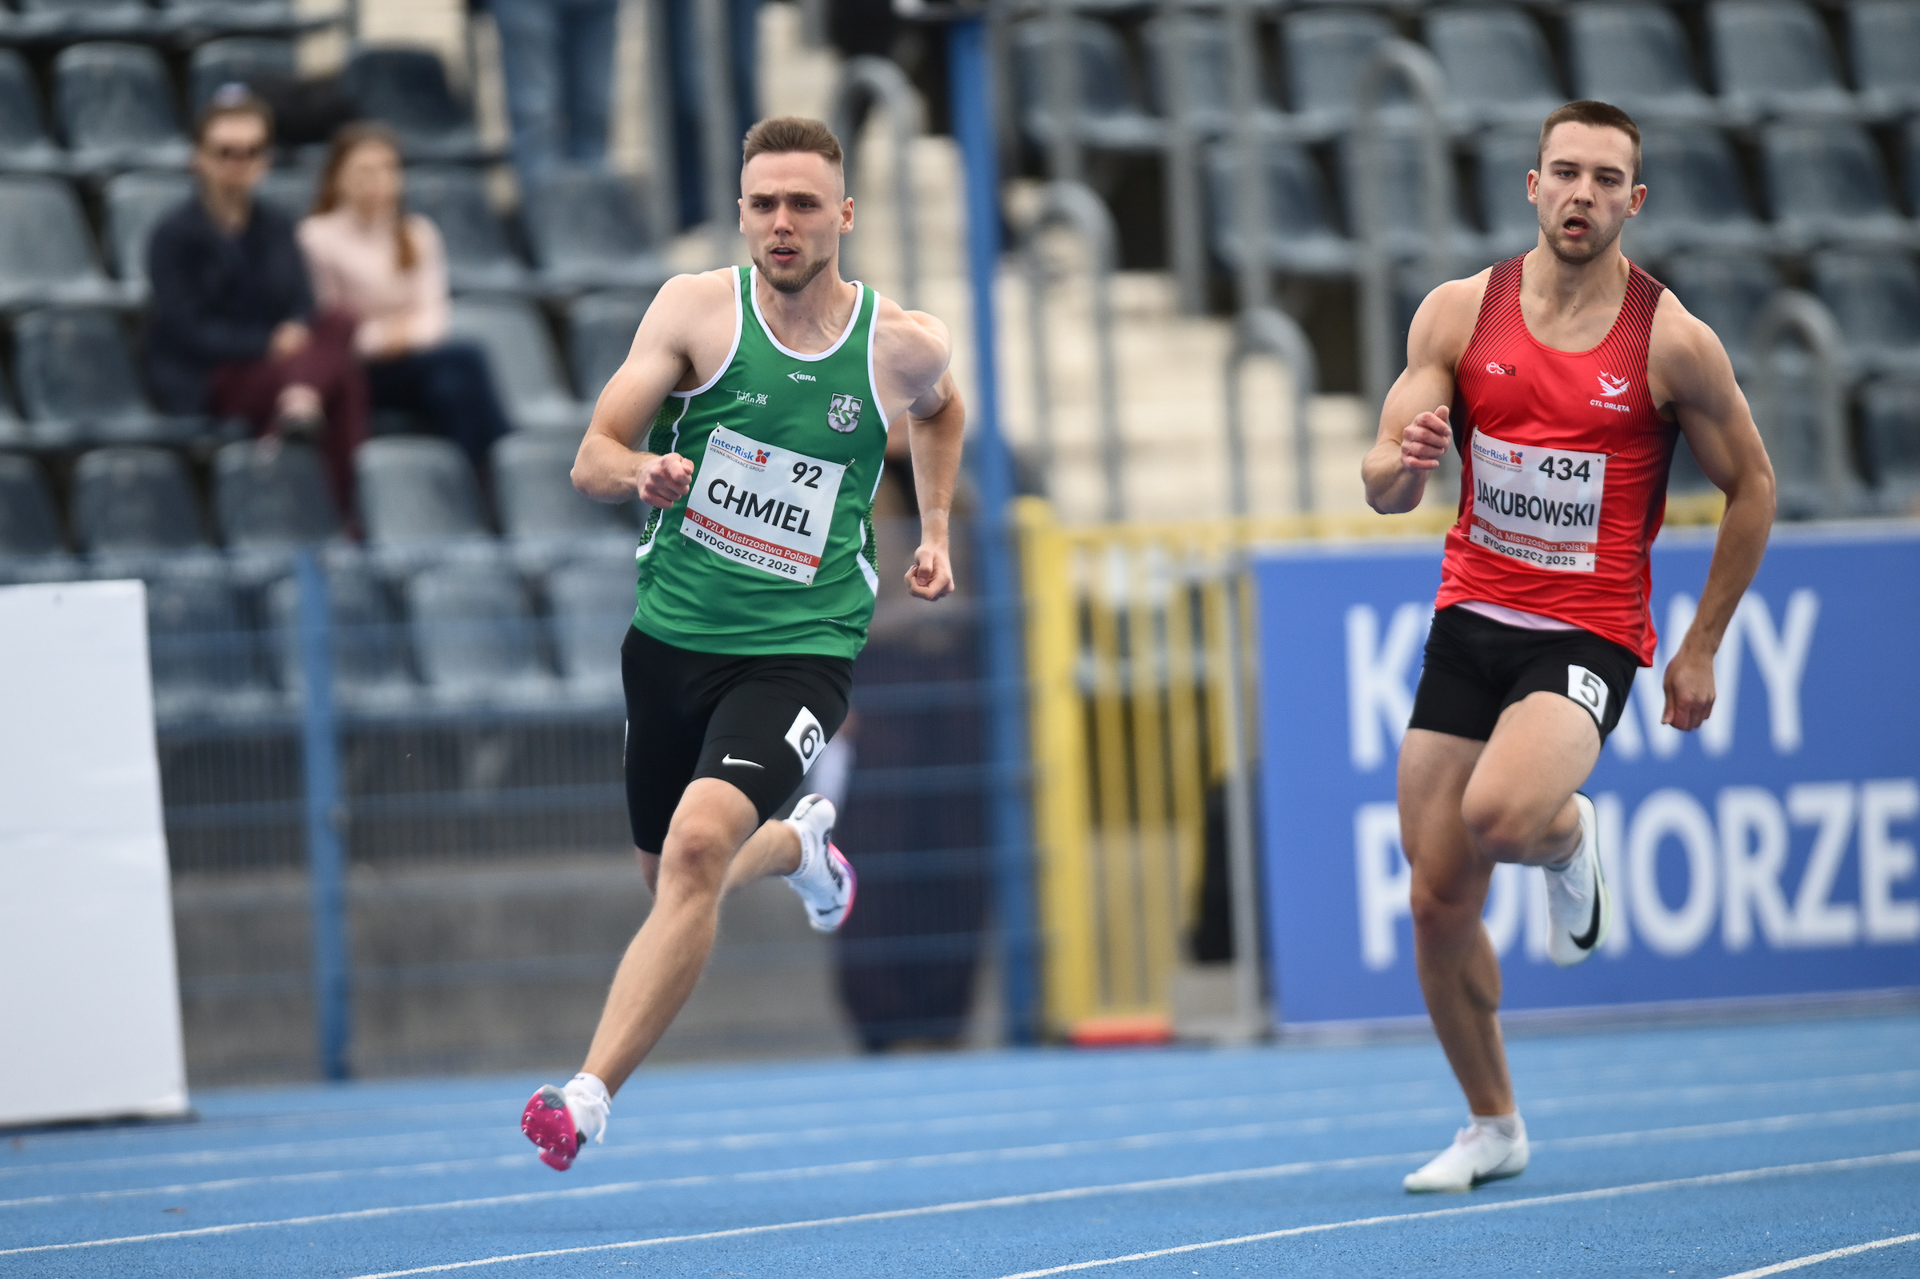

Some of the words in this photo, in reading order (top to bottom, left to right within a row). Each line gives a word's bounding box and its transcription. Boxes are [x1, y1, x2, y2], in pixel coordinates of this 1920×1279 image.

[1486, 362, 1516, 376] esa
[1590, 399, 1603, 407] CTL
[711, 435, 755, 460] InterRisk
[1473, 440, 1508, 462] InterRisk
[791, 461, 823, 489] 92
[1538, 456, 1591, 482] 434
[707, 478, 811, 536] CHMIEL
[1477, 478, 1595, 527] JAKUBOWSKI
[691, 512, 704, 525] 101.
[706, 520, 725, 537] PZLA
[726, 530, 783, 555] Mistrzostwa
[784, 549, 813, 564] Polski
[695, 529, 766, 565] BYDGOSZCZ
[766, 558, 798, 574] 2025
[1483, 534, 1543, 563] BYDGOSZCZ
[1545, 555, 1576, 566] 2025
[1505, 532, 1558, 551] Mistrzostwa
[1560, 542, 1589, 552] Polski
[1580, 671, 1601, 707] 5
[799, 723, 820, 759] 6
